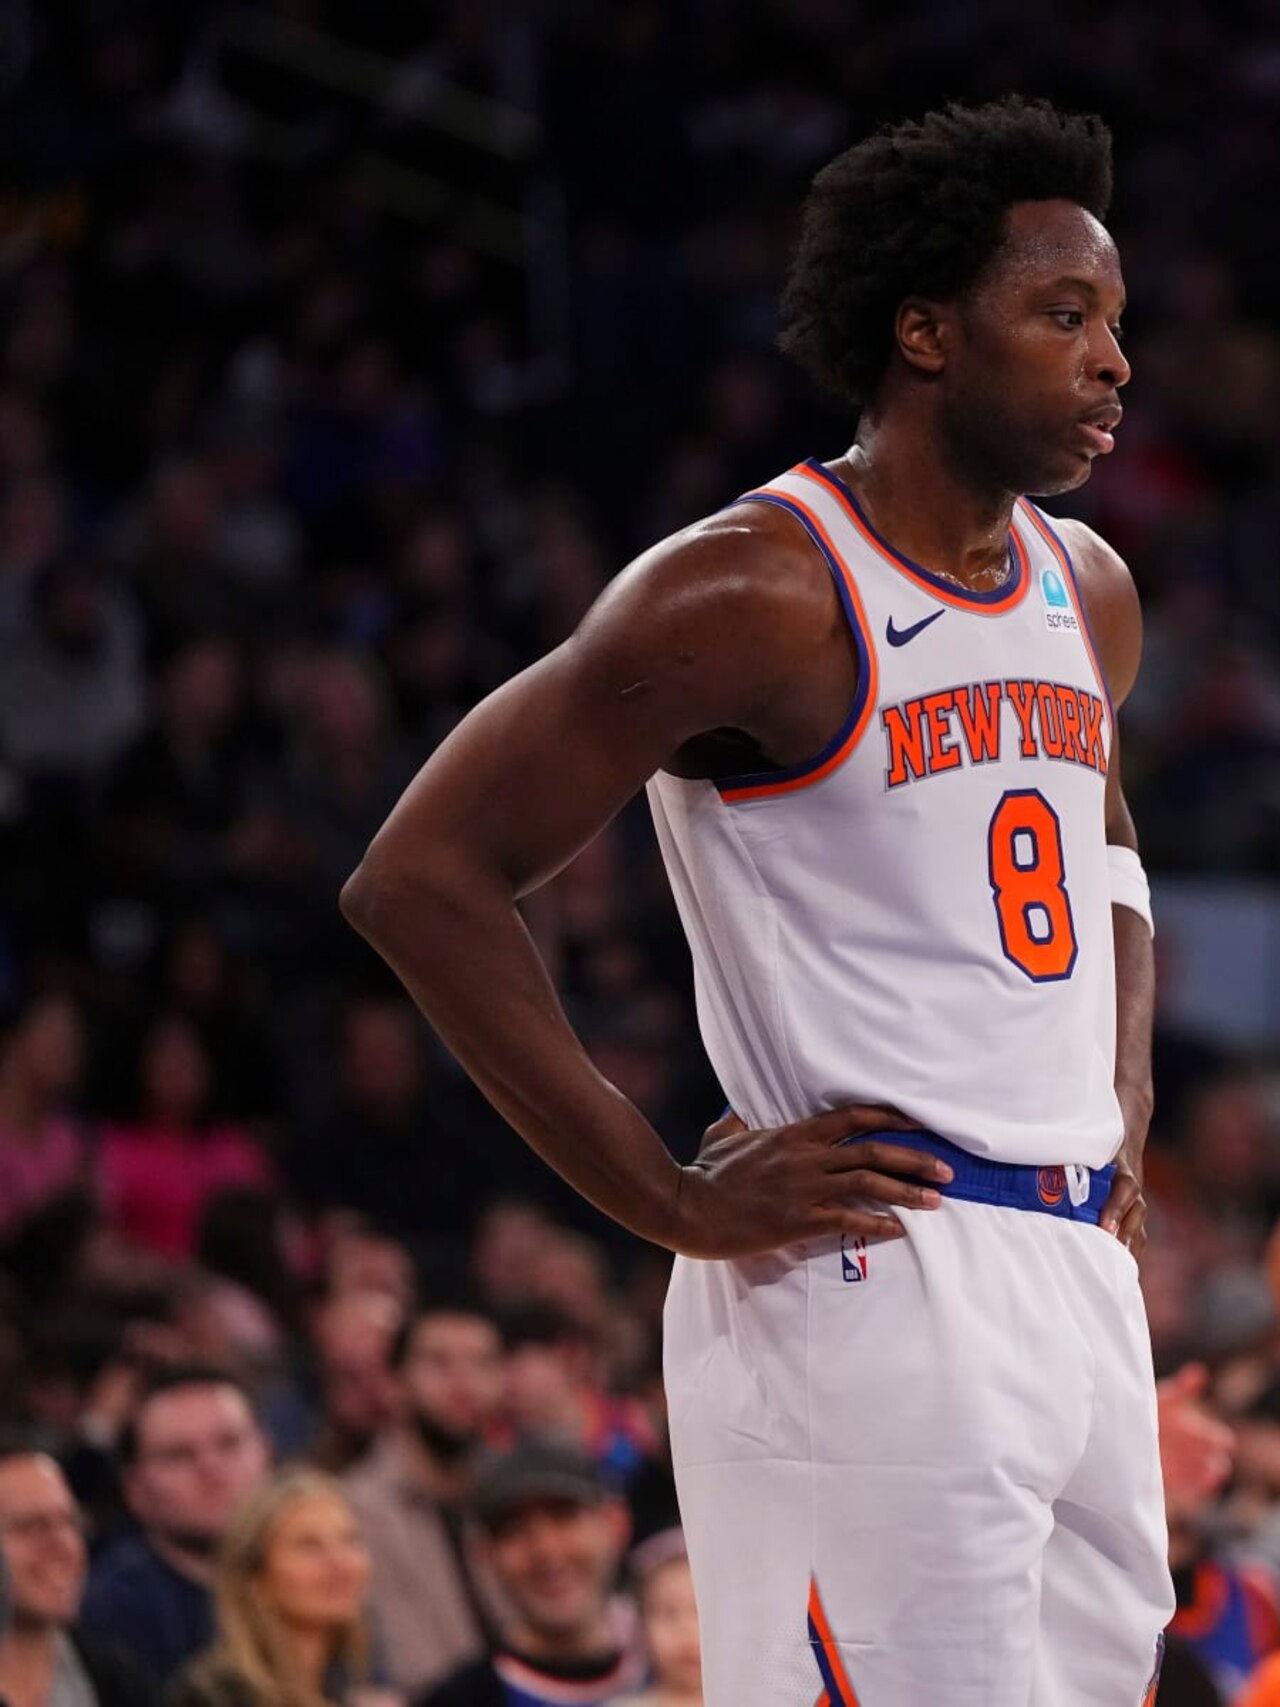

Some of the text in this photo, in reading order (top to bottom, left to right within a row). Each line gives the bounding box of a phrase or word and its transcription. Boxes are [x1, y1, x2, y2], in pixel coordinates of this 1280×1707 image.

[880, 679, 1109, 791] NEW YORK
[987, 787, 1079, 983] 8
